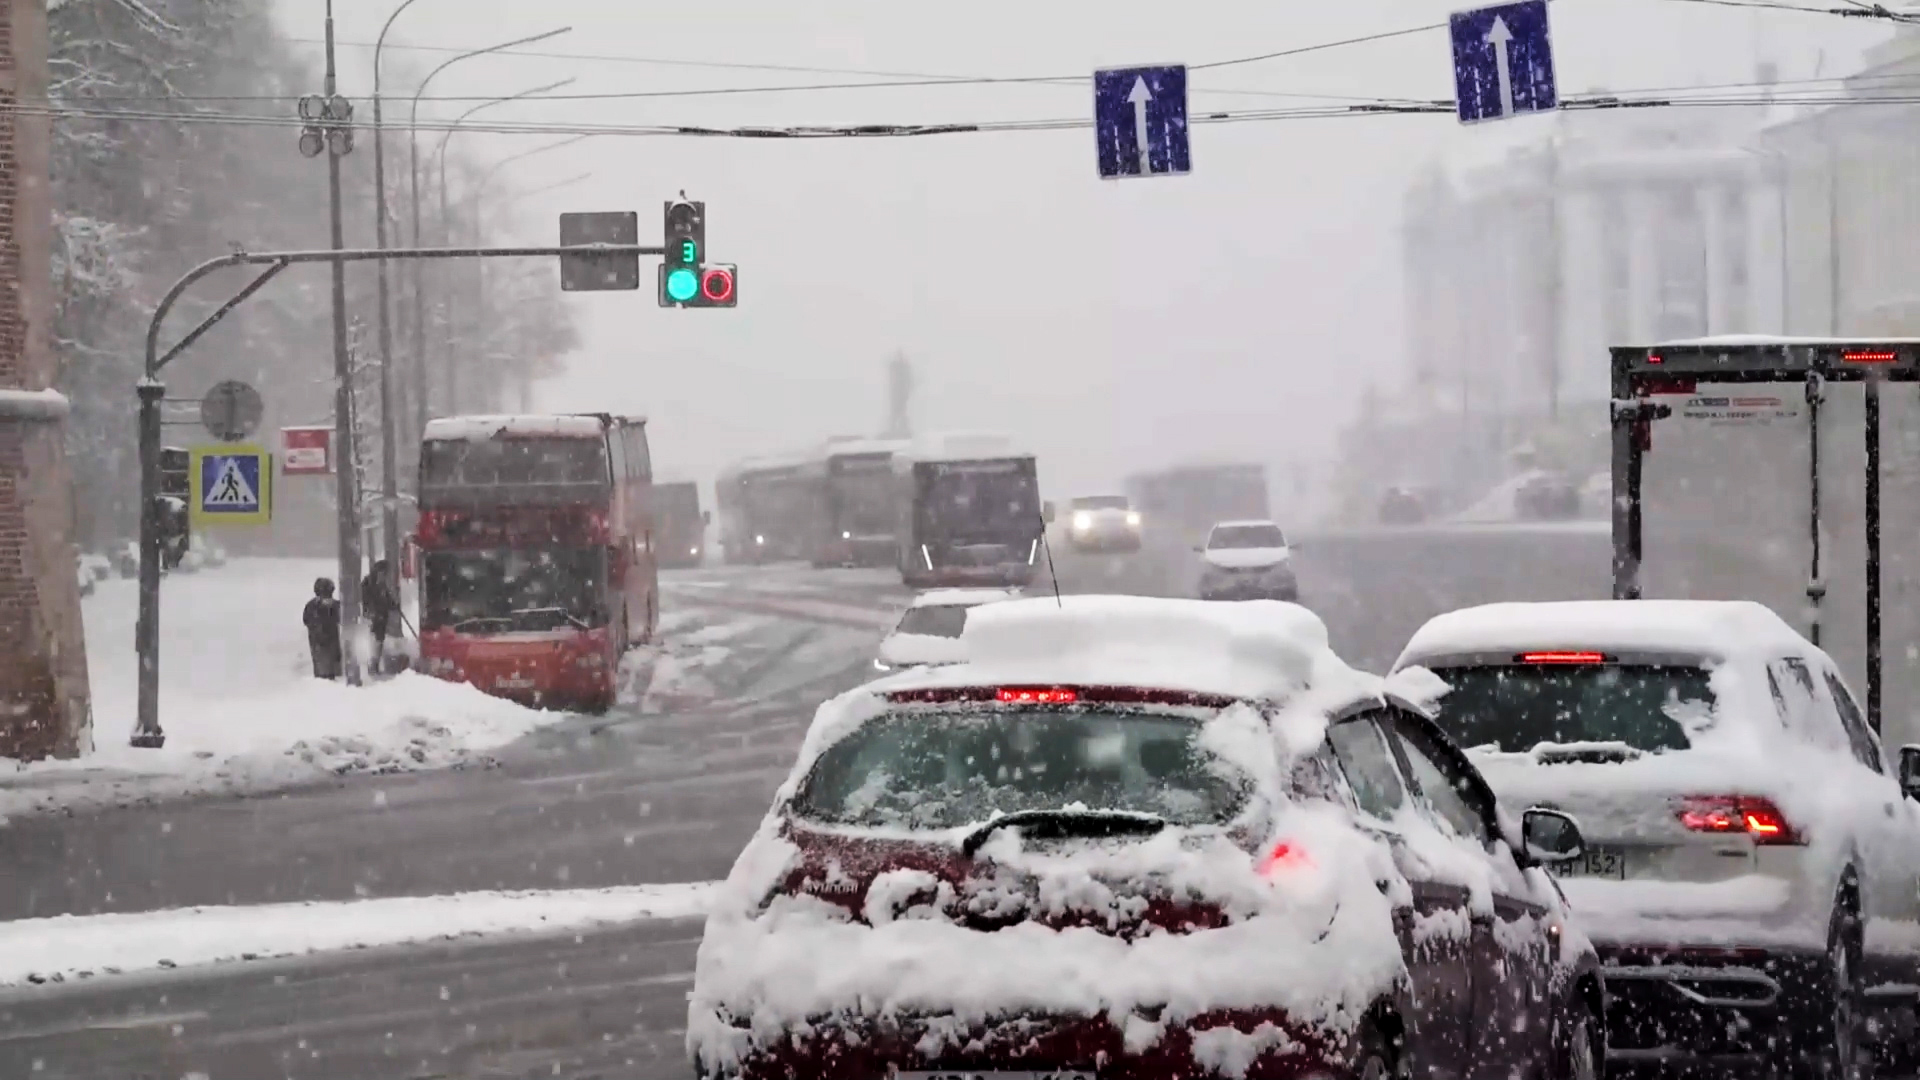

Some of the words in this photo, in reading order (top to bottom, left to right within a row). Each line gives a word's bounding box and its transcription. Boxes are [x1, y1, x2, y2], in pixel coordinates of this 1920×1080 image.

[683, 242, 694, 263] 3
[1584, 854, 1616, 874] 152
[803, 880, 858, 895] YUNDAI
